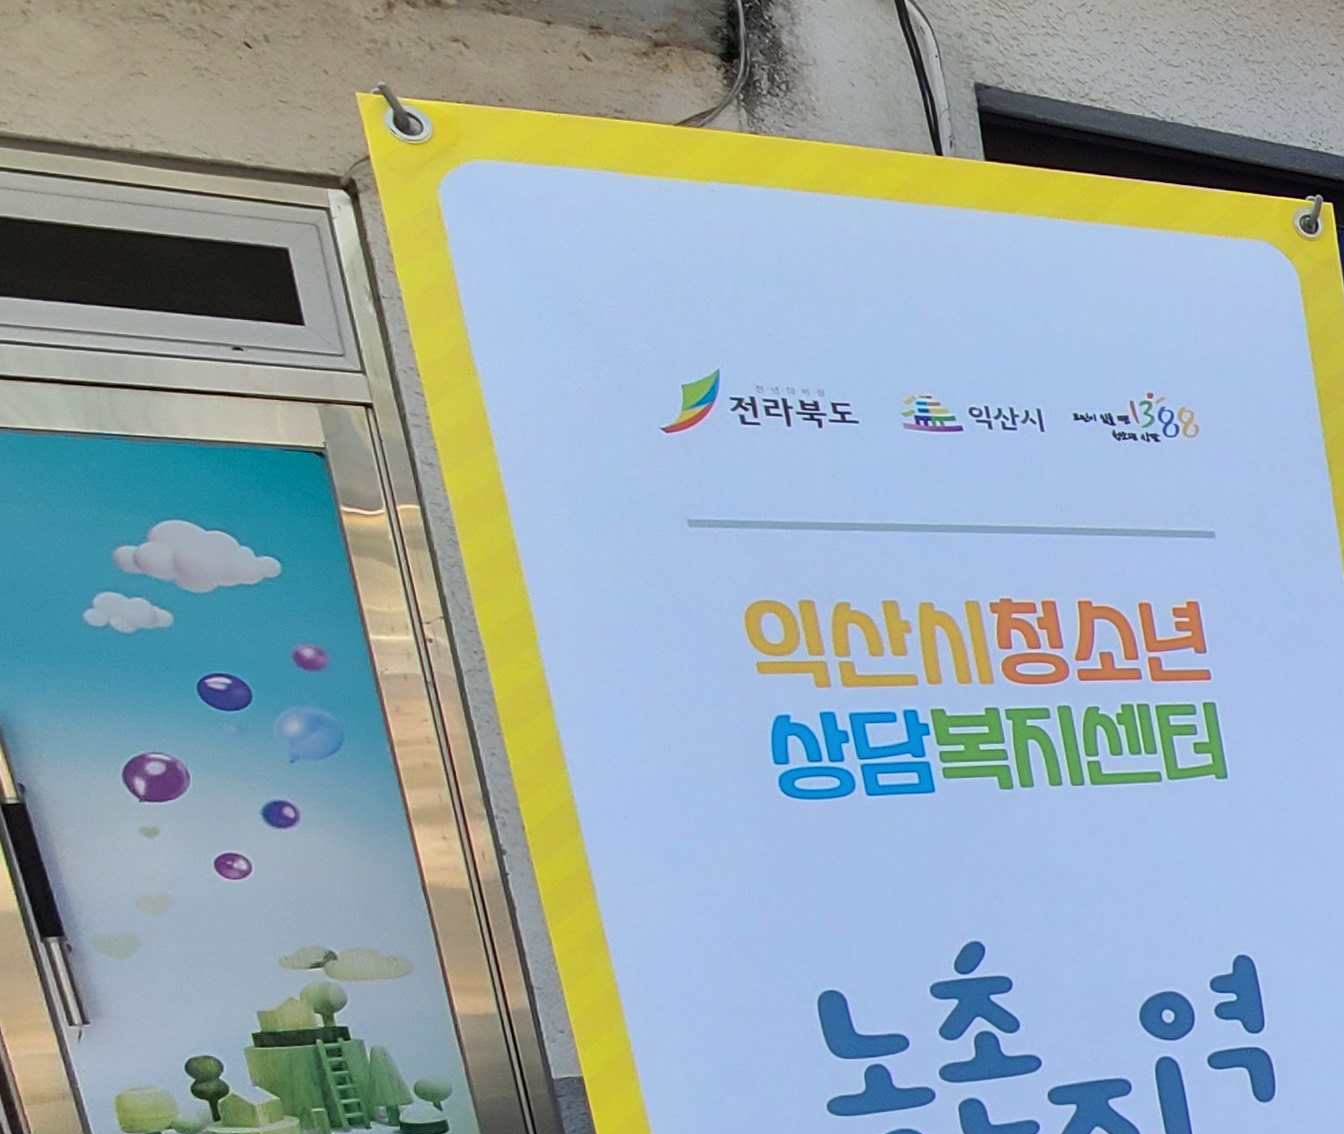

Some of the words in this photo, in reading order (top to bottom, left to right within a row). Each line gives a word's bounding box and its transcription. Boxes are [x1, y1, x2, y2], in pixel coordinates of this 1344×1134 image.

[728, 396, 860, 429] 전라북도
[968, 405, 1046, 432] 익산시
[1129, 399, 1200, 438] 1388
[743, 598, 1212, 688] 익산시청소년
[770, 701, 1228, 800] 상담복지센터
